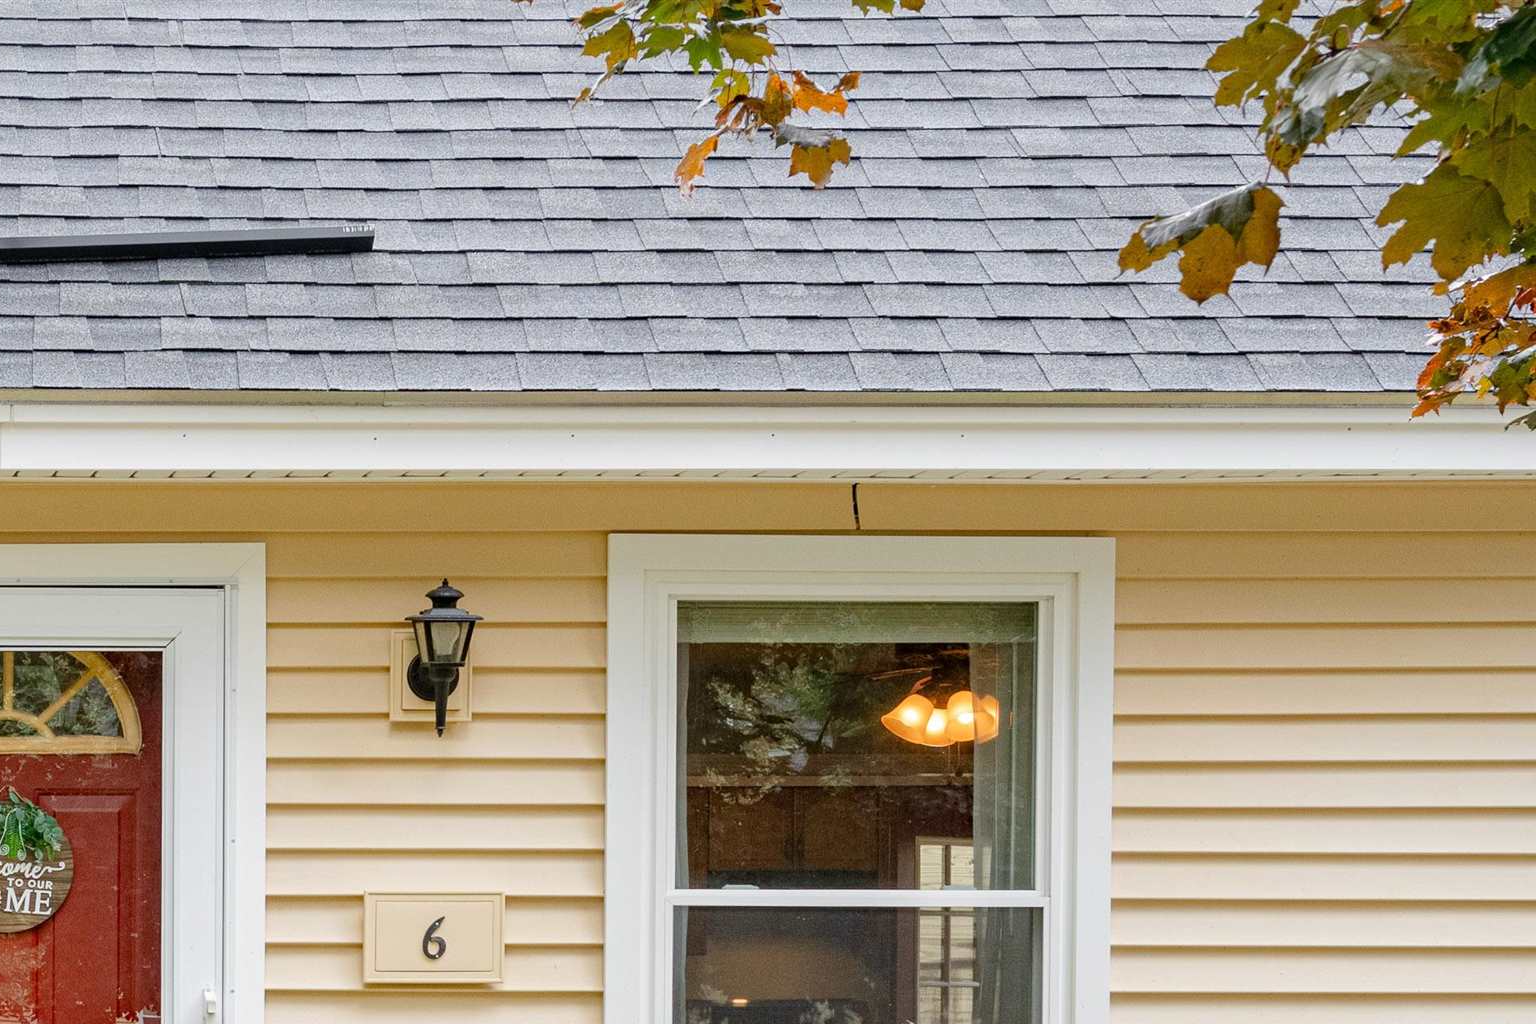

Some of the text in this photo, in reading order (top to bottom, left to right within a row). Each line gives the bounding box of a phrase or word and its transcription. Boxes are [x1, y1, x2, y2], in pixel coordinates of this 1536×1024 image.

[7, 877, 54, 890] TO OUR
[422, 916, 446, 960] 6
